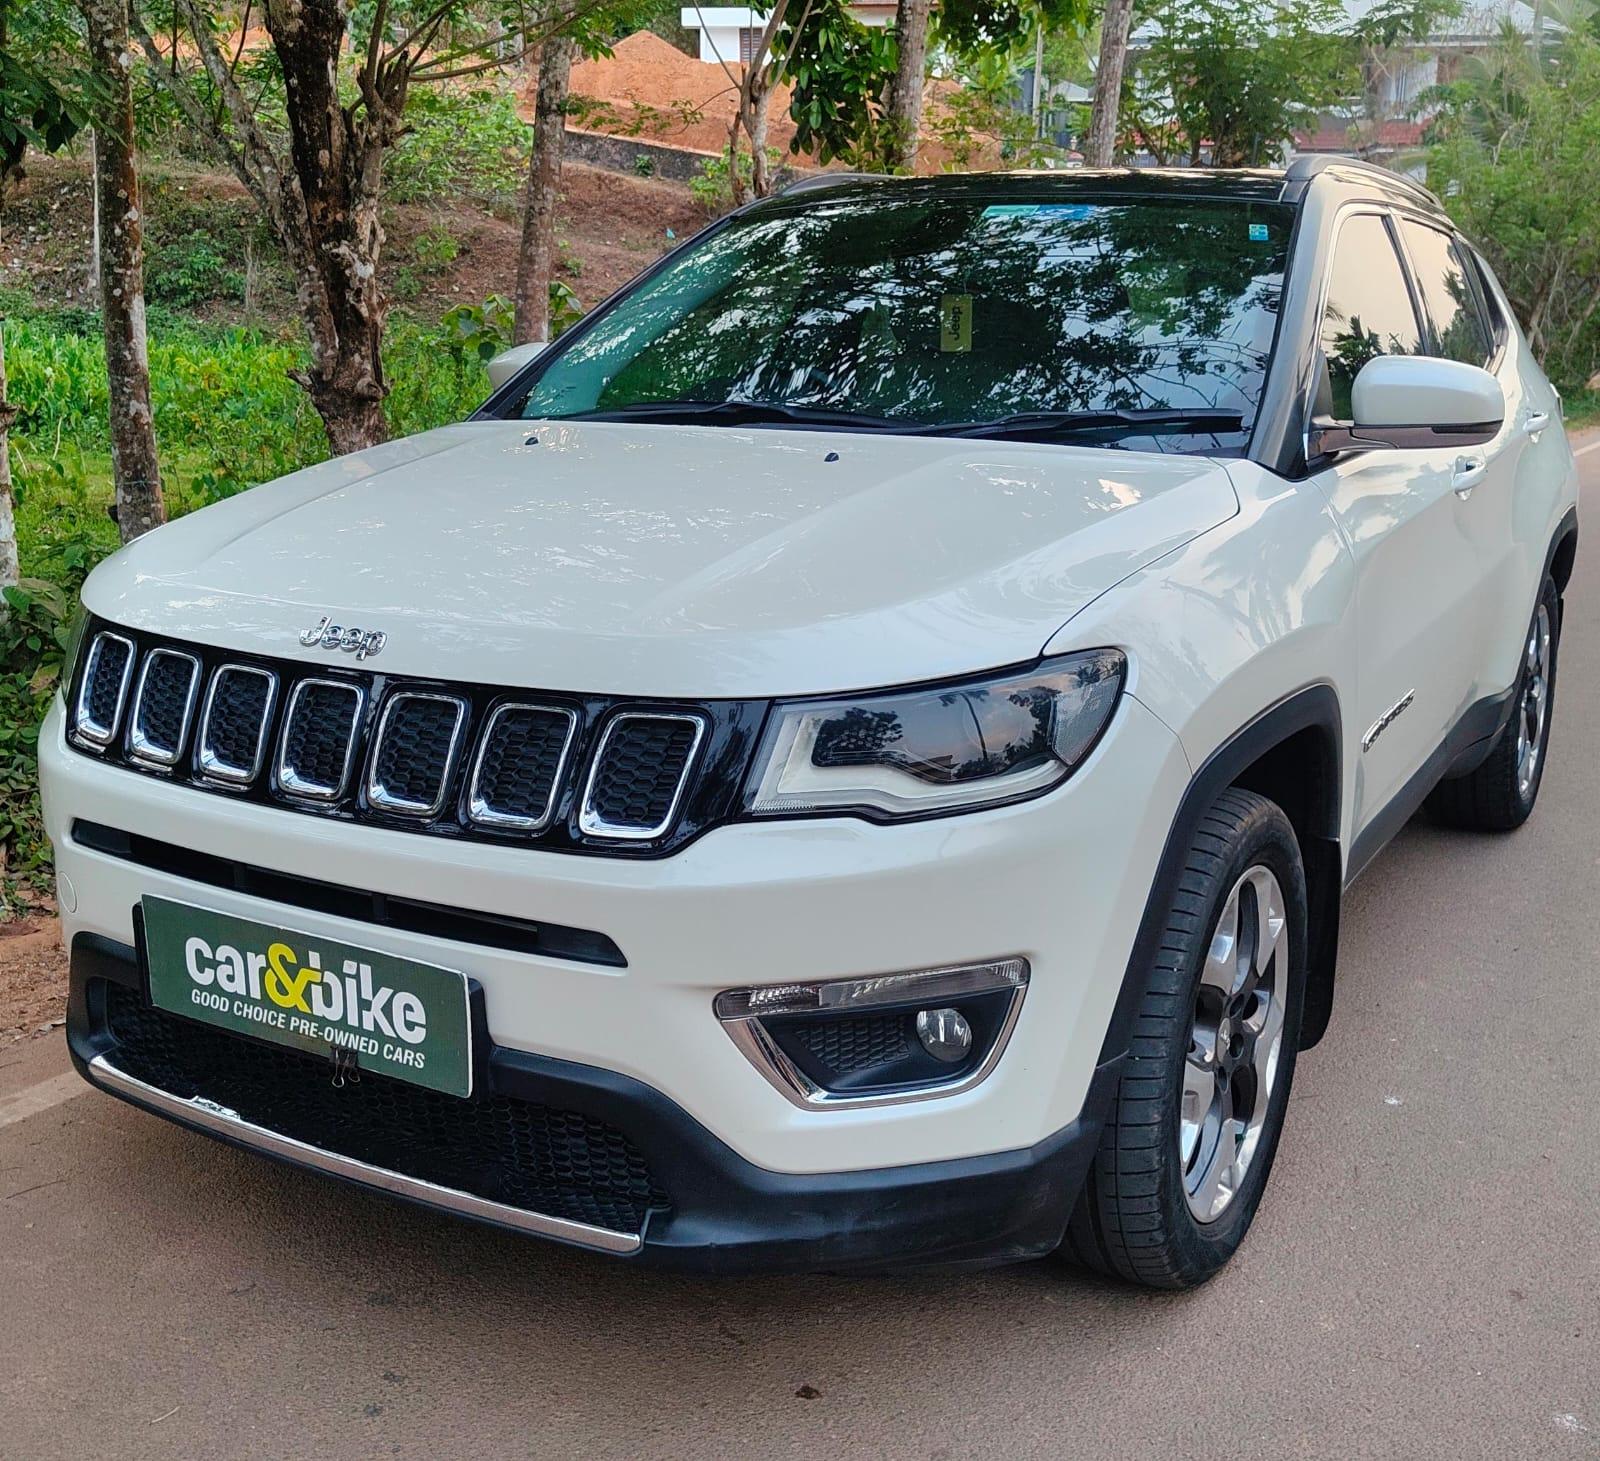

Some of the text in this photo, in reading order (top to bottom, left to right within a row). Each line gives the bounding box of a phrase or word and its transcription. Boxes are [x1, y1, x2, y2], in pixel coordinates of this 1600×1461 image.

[948, 305, 963, 341] Jeep
[299, 616, 387, 661] Jeep
[185, 937, 426, 1044] car&bike
[191, 988, 426, 1069] GOOD CHOICE PRE-OWNED CARS
